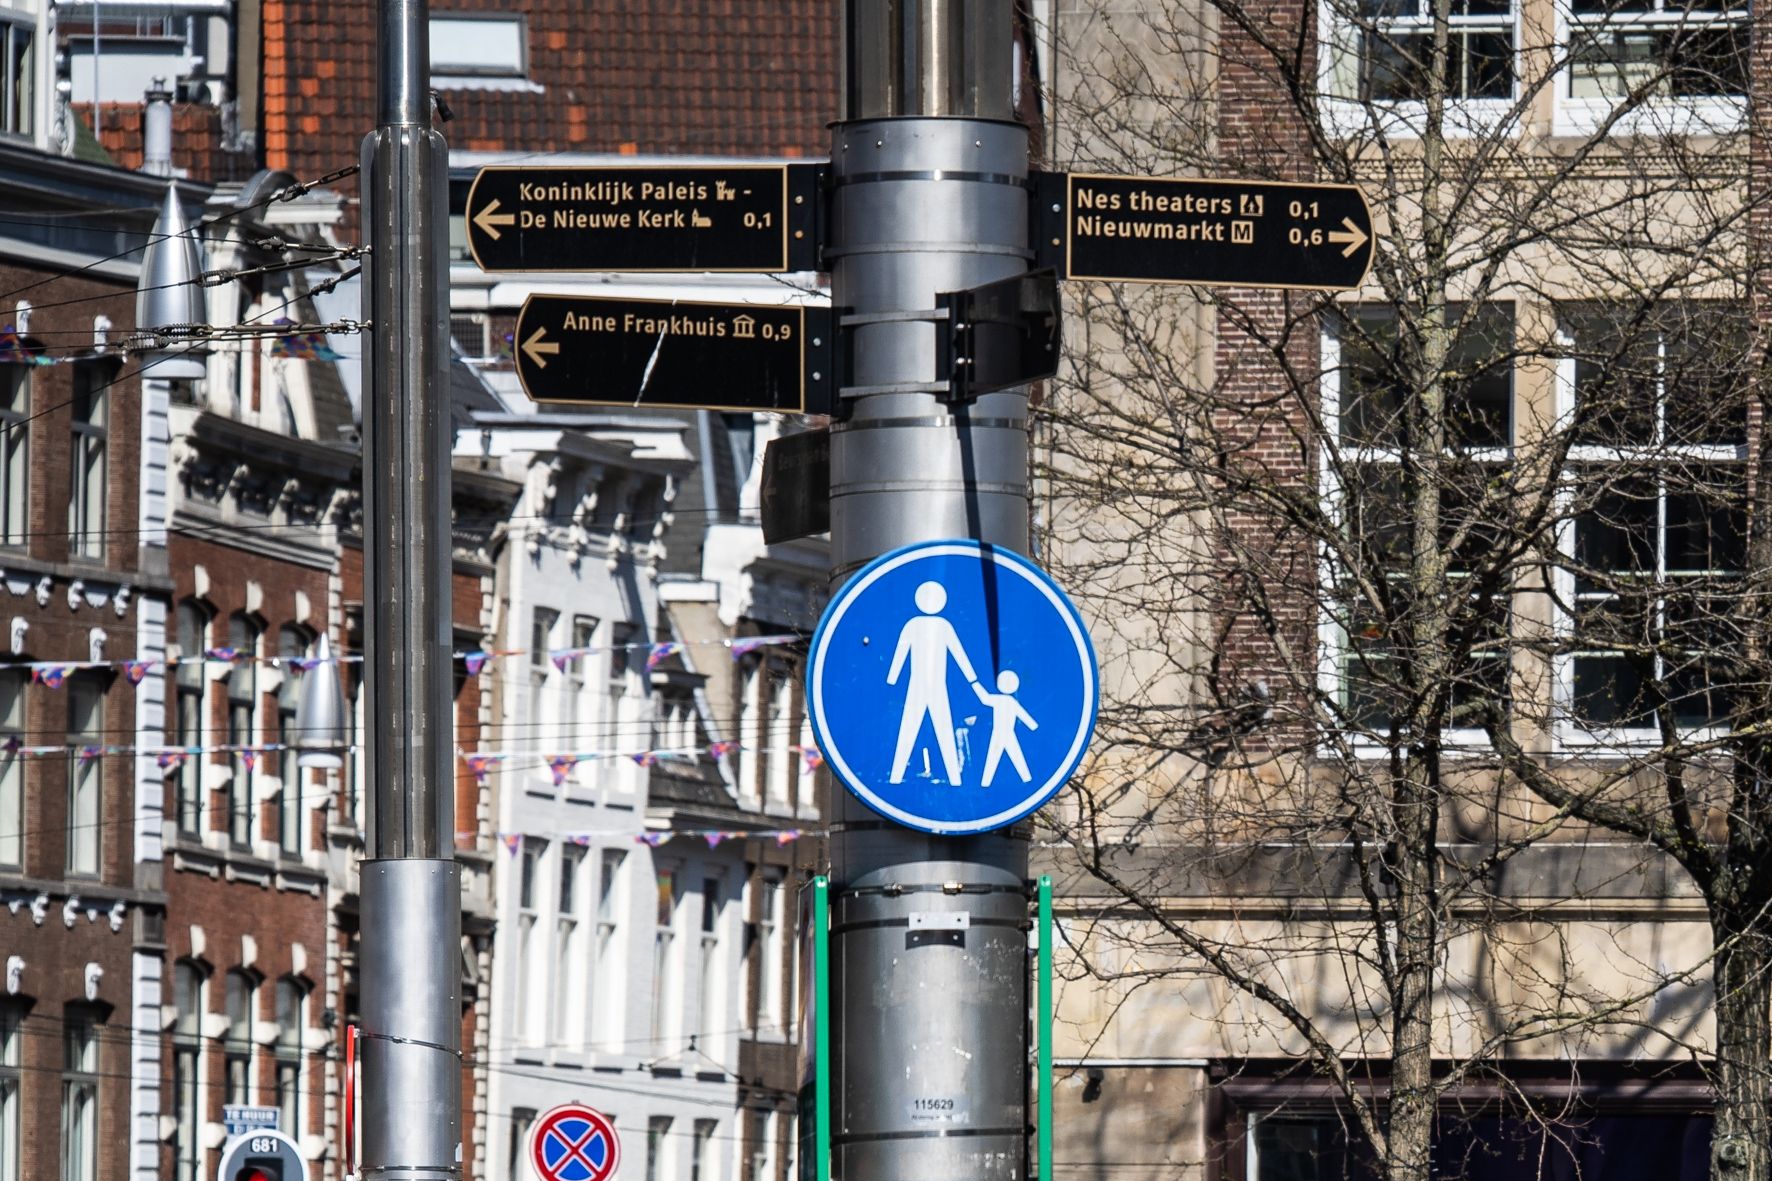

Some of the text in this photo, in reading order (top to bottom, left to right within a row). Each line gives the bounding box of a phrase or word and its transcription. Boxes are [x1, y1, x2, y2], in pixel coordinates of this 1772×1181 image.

[520, 182, 634, 205] Koninklijk
[641, 181, 708, 201] Paleis
[1076, 188, 1319, 220] Nes theaters 0,1
[520, 209, 772, 229] De Nieuwe Kerk 0,1
[1076, 216, 1225, 241] Nieuwmarkt
[1288, 228, 1324, 247] 0,6
[563, 311, 792, 341] Anne Frankhuis 0,9
[914, 1099, 954, 1110] 115629
[251, 1138, 278, 1152] 681
